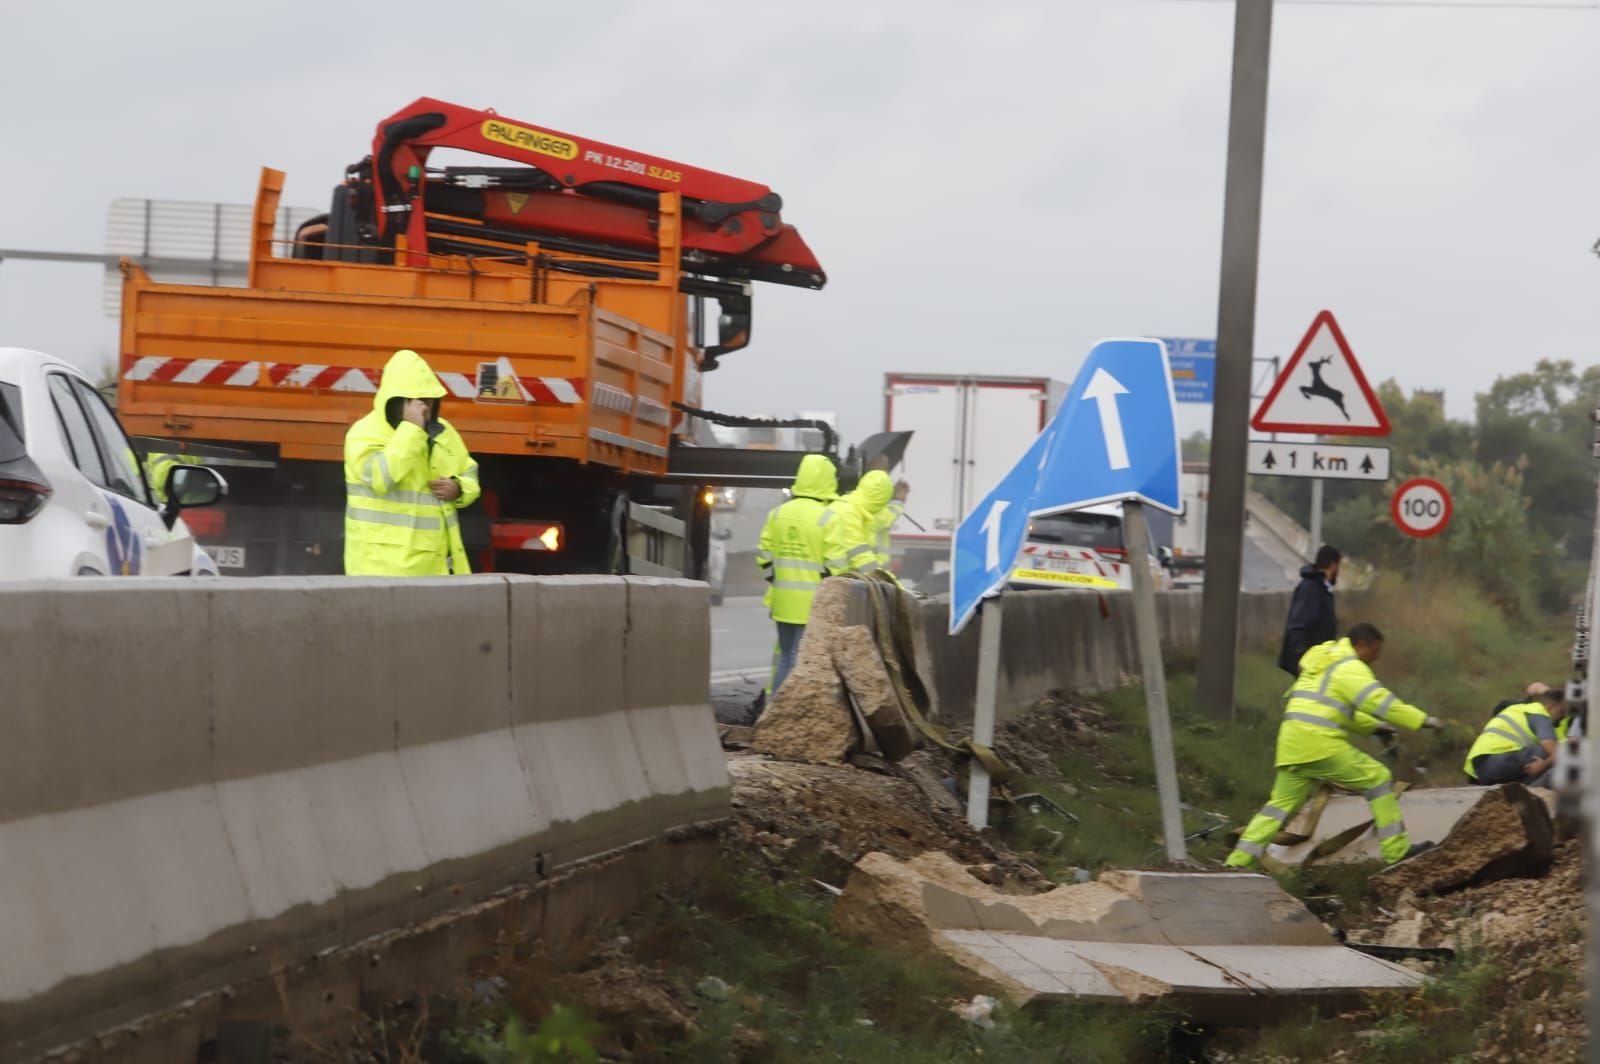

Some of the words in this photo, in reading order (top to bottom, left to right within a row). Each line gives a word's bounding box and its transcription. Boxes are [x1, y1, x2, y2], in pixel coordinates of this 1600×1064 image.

[487, 123, 571, 157] PALFINGER
[584, 151, 603, 165] PK
[606, 156, 646, 175] 12.501
[1289, 450, 1297, 468] 1
[1312, 452, 1347, 471] km
[1404, 498, 1440, 517] 100
